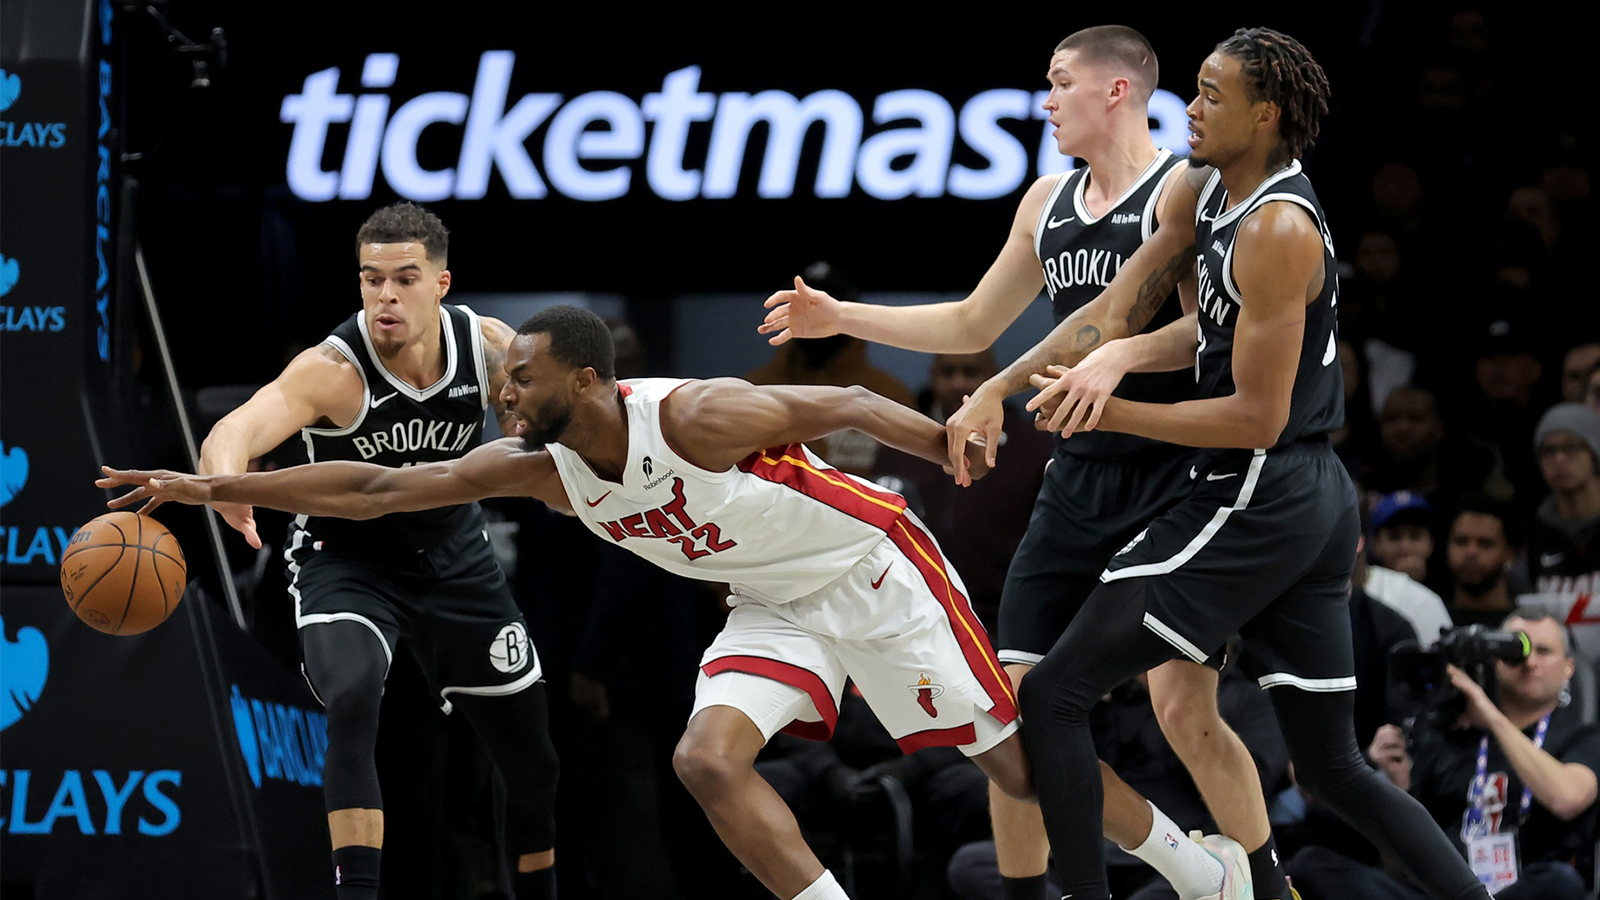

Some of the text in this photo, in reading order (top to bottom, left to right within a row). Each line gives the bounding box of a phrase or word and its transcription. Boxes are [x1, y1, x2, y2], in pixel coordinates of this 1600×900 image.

[96, 59, 113, 361] BARCLAYS
[643, 468, 675, 491] Robinhood
[595, 476, 698, 543] HEAT
[666, 522, 738, 561] 22
[506, 630, 520, 667] B
[0, 769, 183, 837] LAYS
